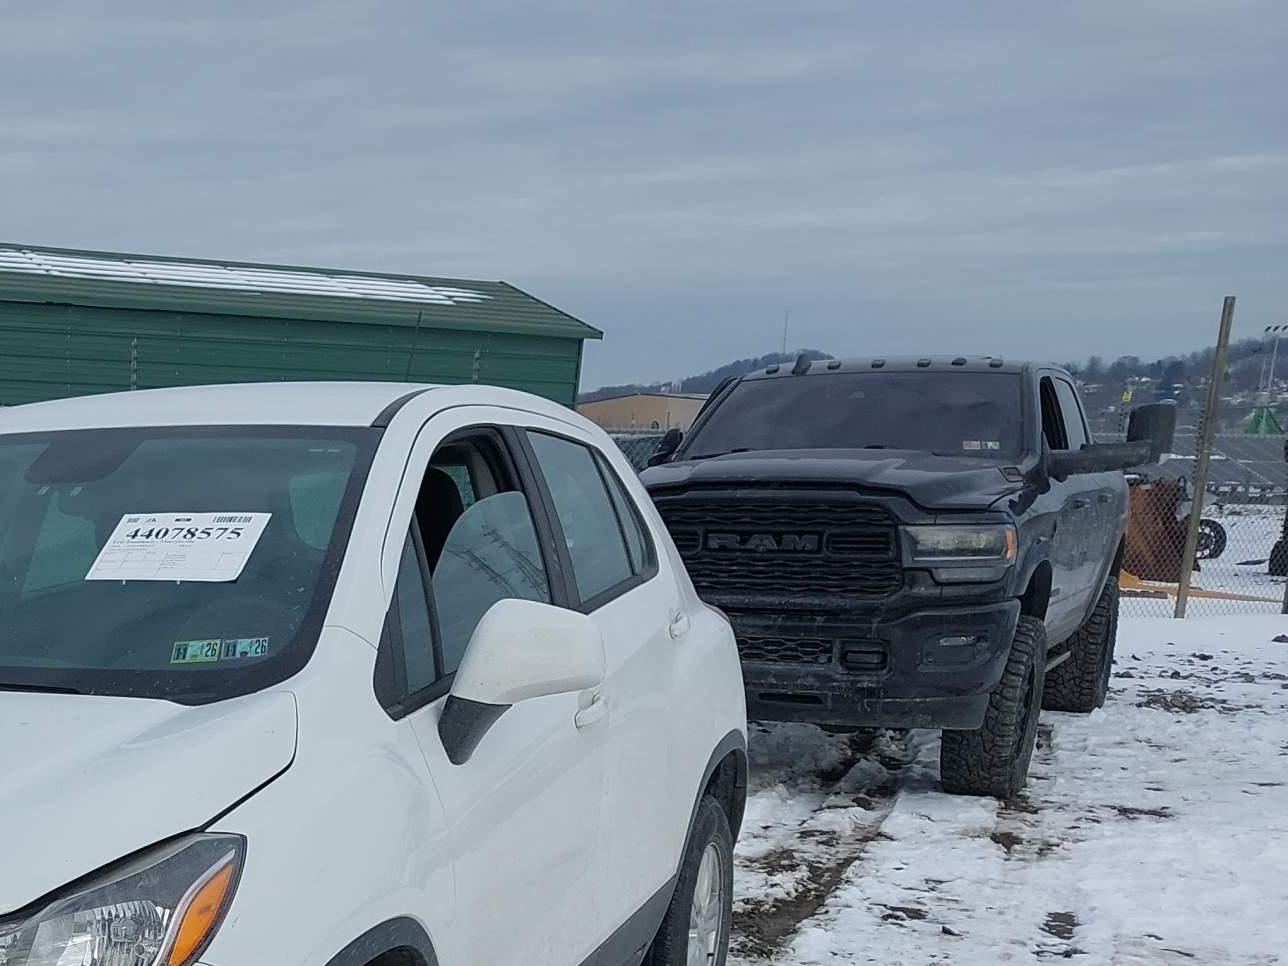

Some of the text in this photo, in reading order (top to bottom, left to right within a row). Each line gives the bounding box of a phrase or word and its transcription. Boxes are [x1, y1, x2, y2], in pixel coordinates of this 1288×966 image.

[125, 526, 245, 540] 44078575
[707, 533, 819, 551] RAM
[205, 642, 218, 658] 26
[254, 639, 267, 655] 26
